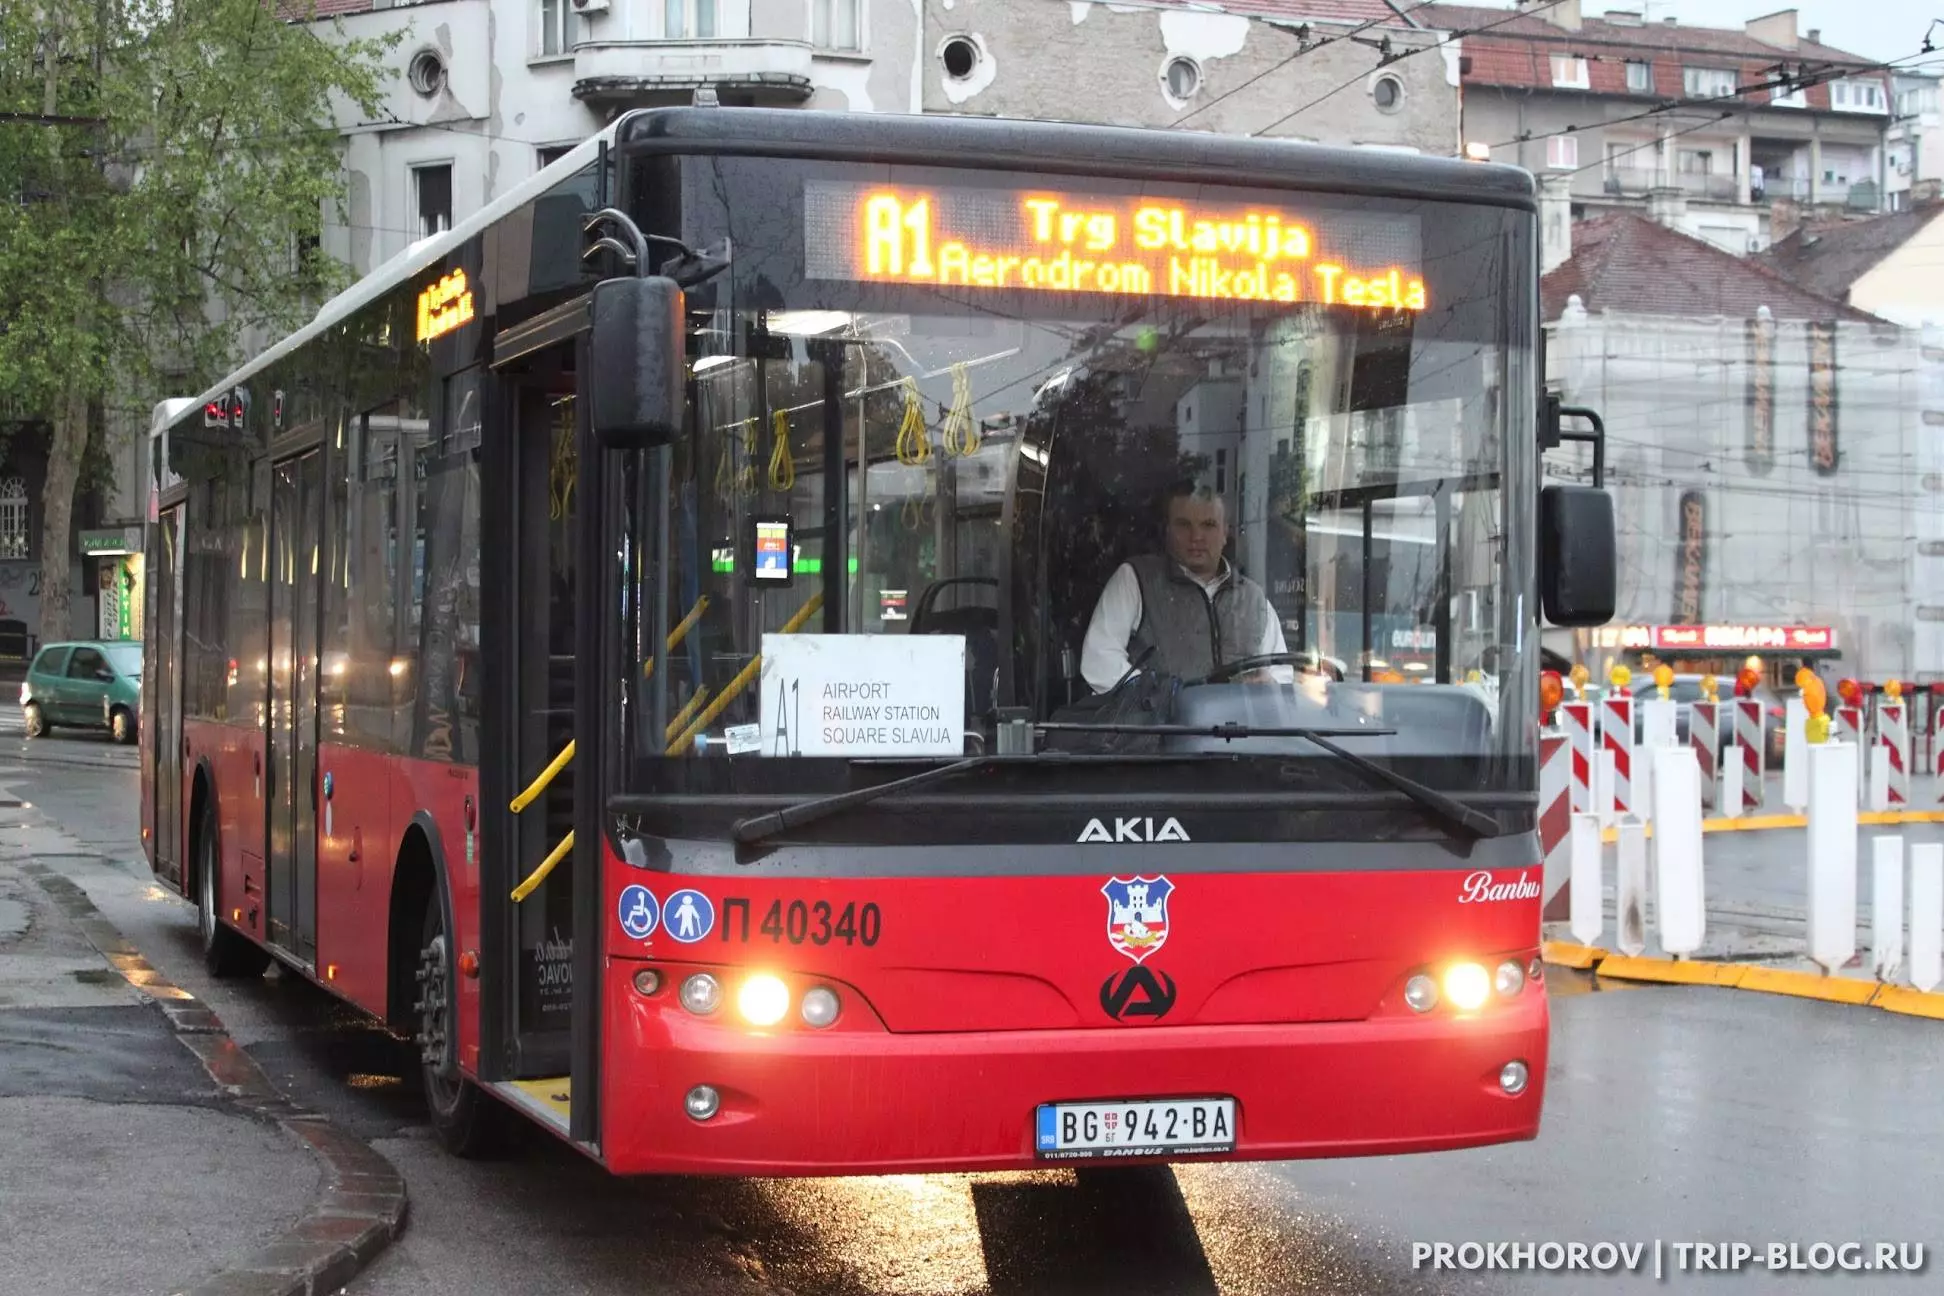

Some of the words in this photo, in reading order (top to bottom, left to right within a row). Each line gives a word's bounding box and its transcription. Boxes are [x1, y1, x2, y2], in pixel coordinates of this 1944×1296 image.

[864, 195, 937, 278] A1
[1026, 198, 1116, 252] Trg
[1134, 207, 1311, 263] Slavija
[937, 241, 1150, 294] Aerodrom
[1171, 257, 1298, 302] Nikola
[1314, 264, 1426, 310] Tesla
[823, 683, 890, 700] AIRPORT
[774, 677, 802, 757] A1
[823, 705, 879, 722] RAILWAY
[884, 705, 940, 722] STATION
[823, 727, 888, 745] SQUARE
[892, 727, 951, 745] SLAVIJA
[1076, 817, 1192, 843] AKIA
[760, 899, 882, 947] 40340
[1040, 1135, 1056, 1145] SRB
[1062, 1111, 1098, 1144] BG
[1103, 1147, 1164, 1157] BANBUS
